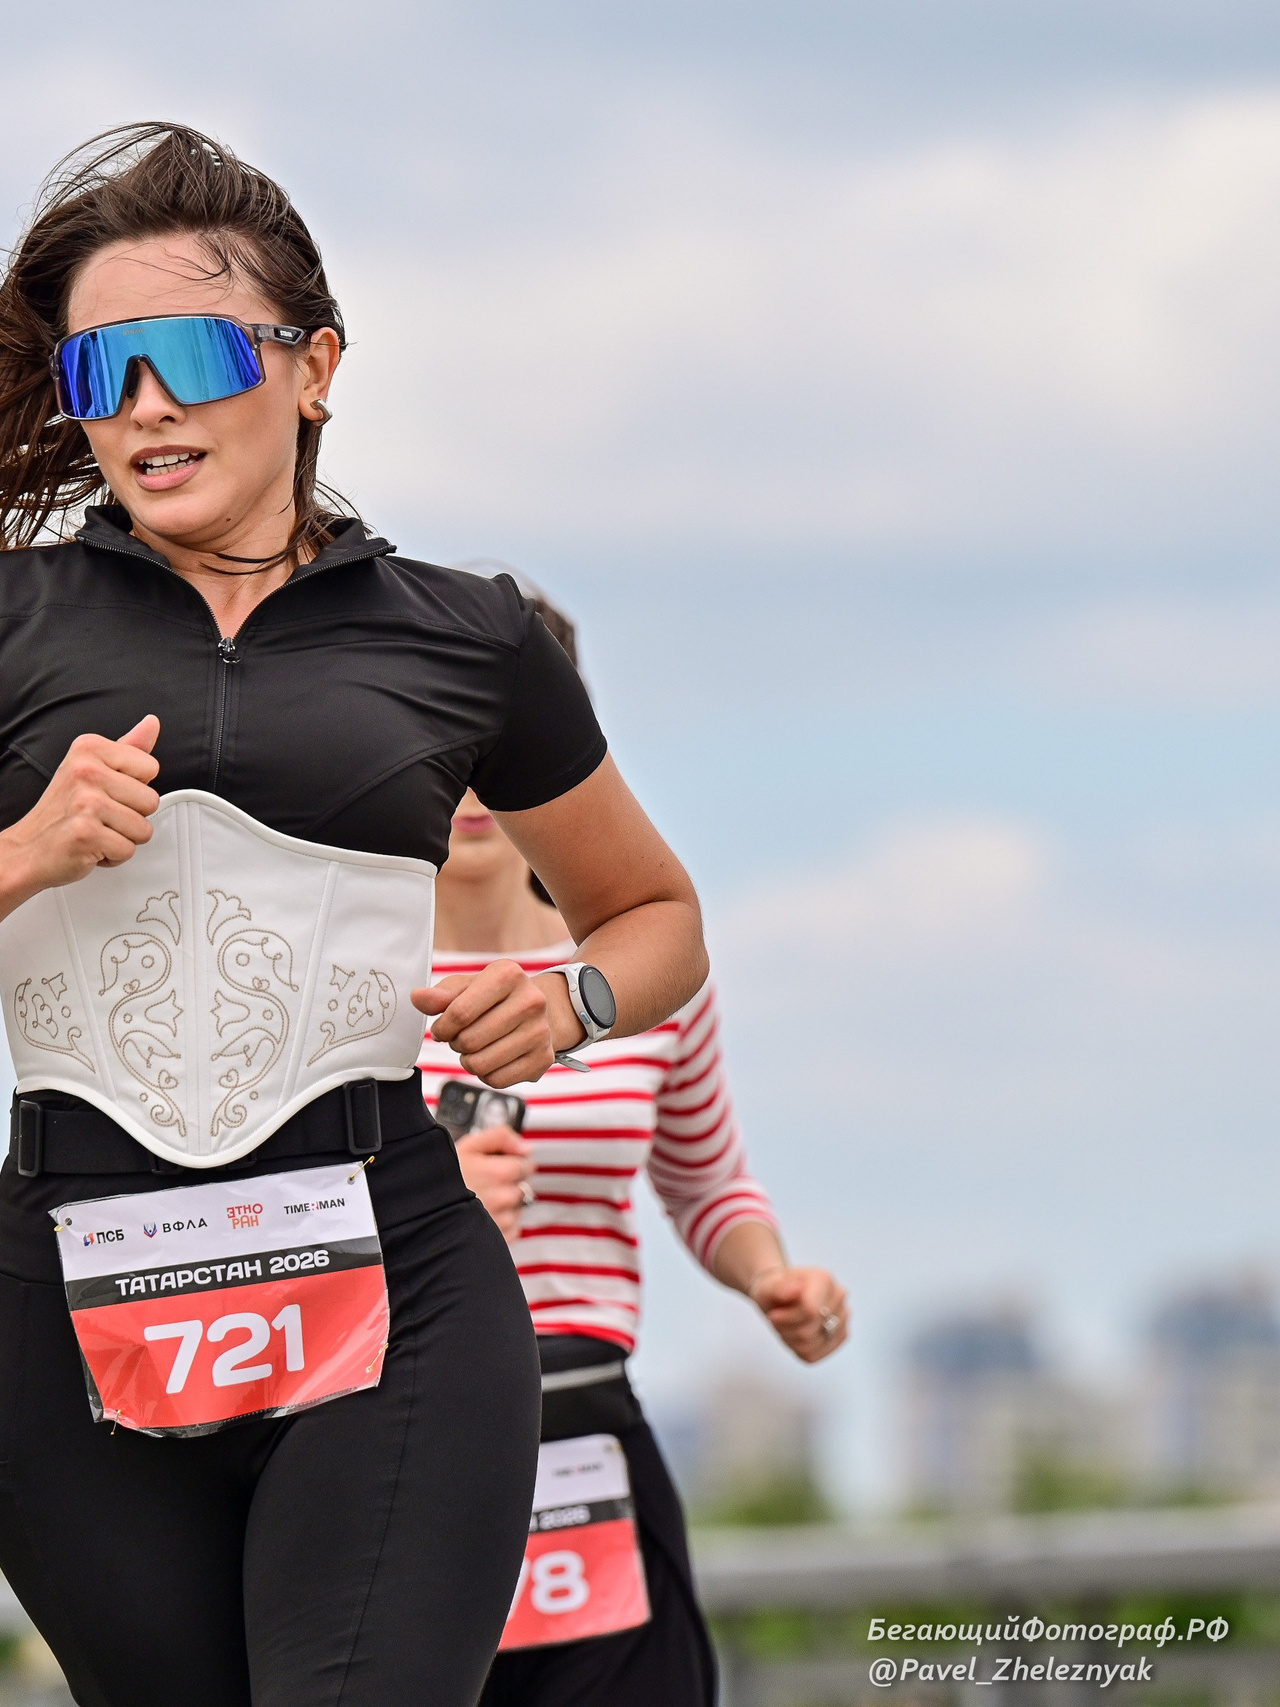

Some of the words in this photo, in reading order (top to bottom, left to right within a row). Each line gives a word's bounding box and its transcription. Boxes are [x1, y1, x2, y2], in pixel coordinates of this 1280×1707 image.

[227, 1203, 263, 1219] ЭТНО
[162, 1218, 208, 1233] ВФЛА
[232, 1214, 259, 1229] РАН
[96, 1229, 125, 1244] ПСБ
[115, 1258, 263, 1296] ТАТАРСТАН
[269, 1249, 331, 1274] 2026
[143, 1303, 306, 1395] 721
